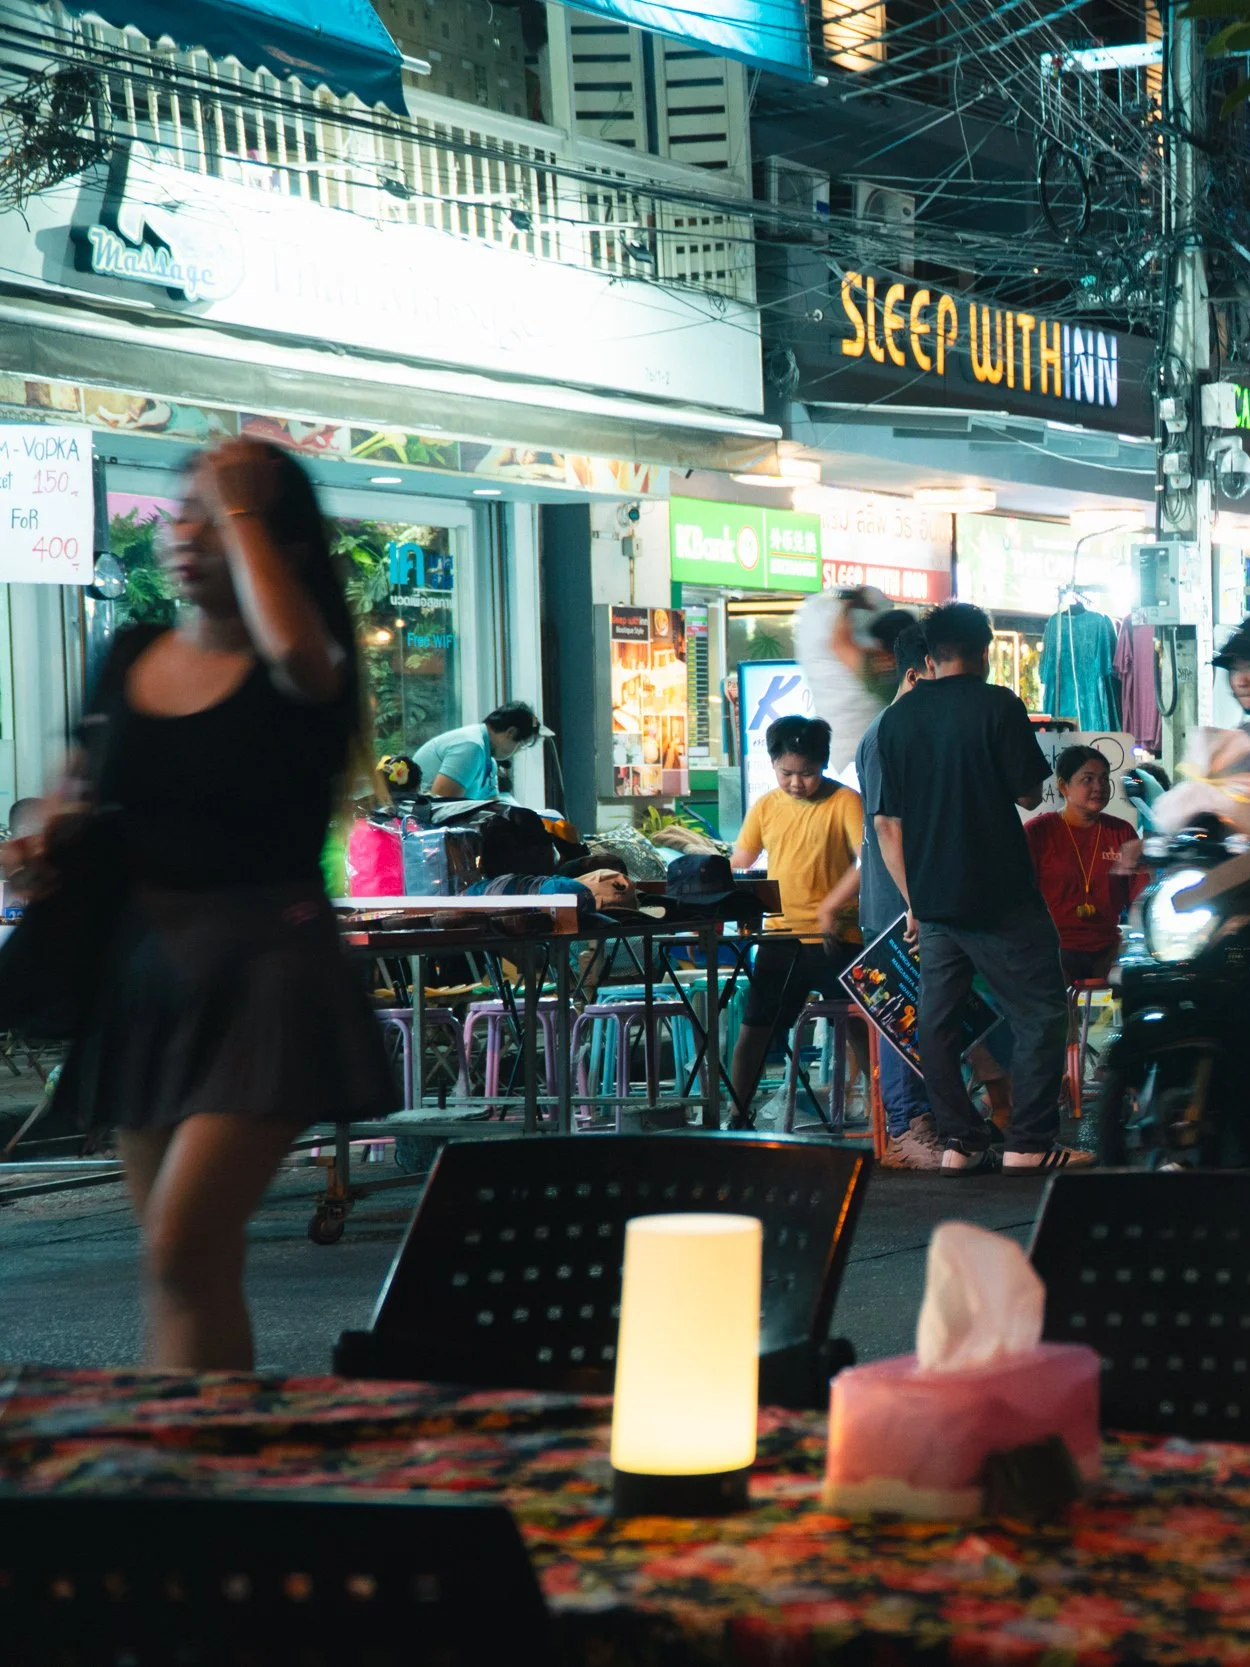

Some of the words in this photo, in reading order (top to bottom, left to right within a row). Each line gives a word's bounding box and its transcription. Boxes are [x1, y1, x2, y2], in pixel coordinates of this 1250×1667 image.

[91, 230, 215, 293] Massage
[841, 271, 959, 376] SLEEP
[675, 522, 738, 563] KBank
[408, 632, 430, 648] Free
[891, 958, 915, 987] MARGARITA
